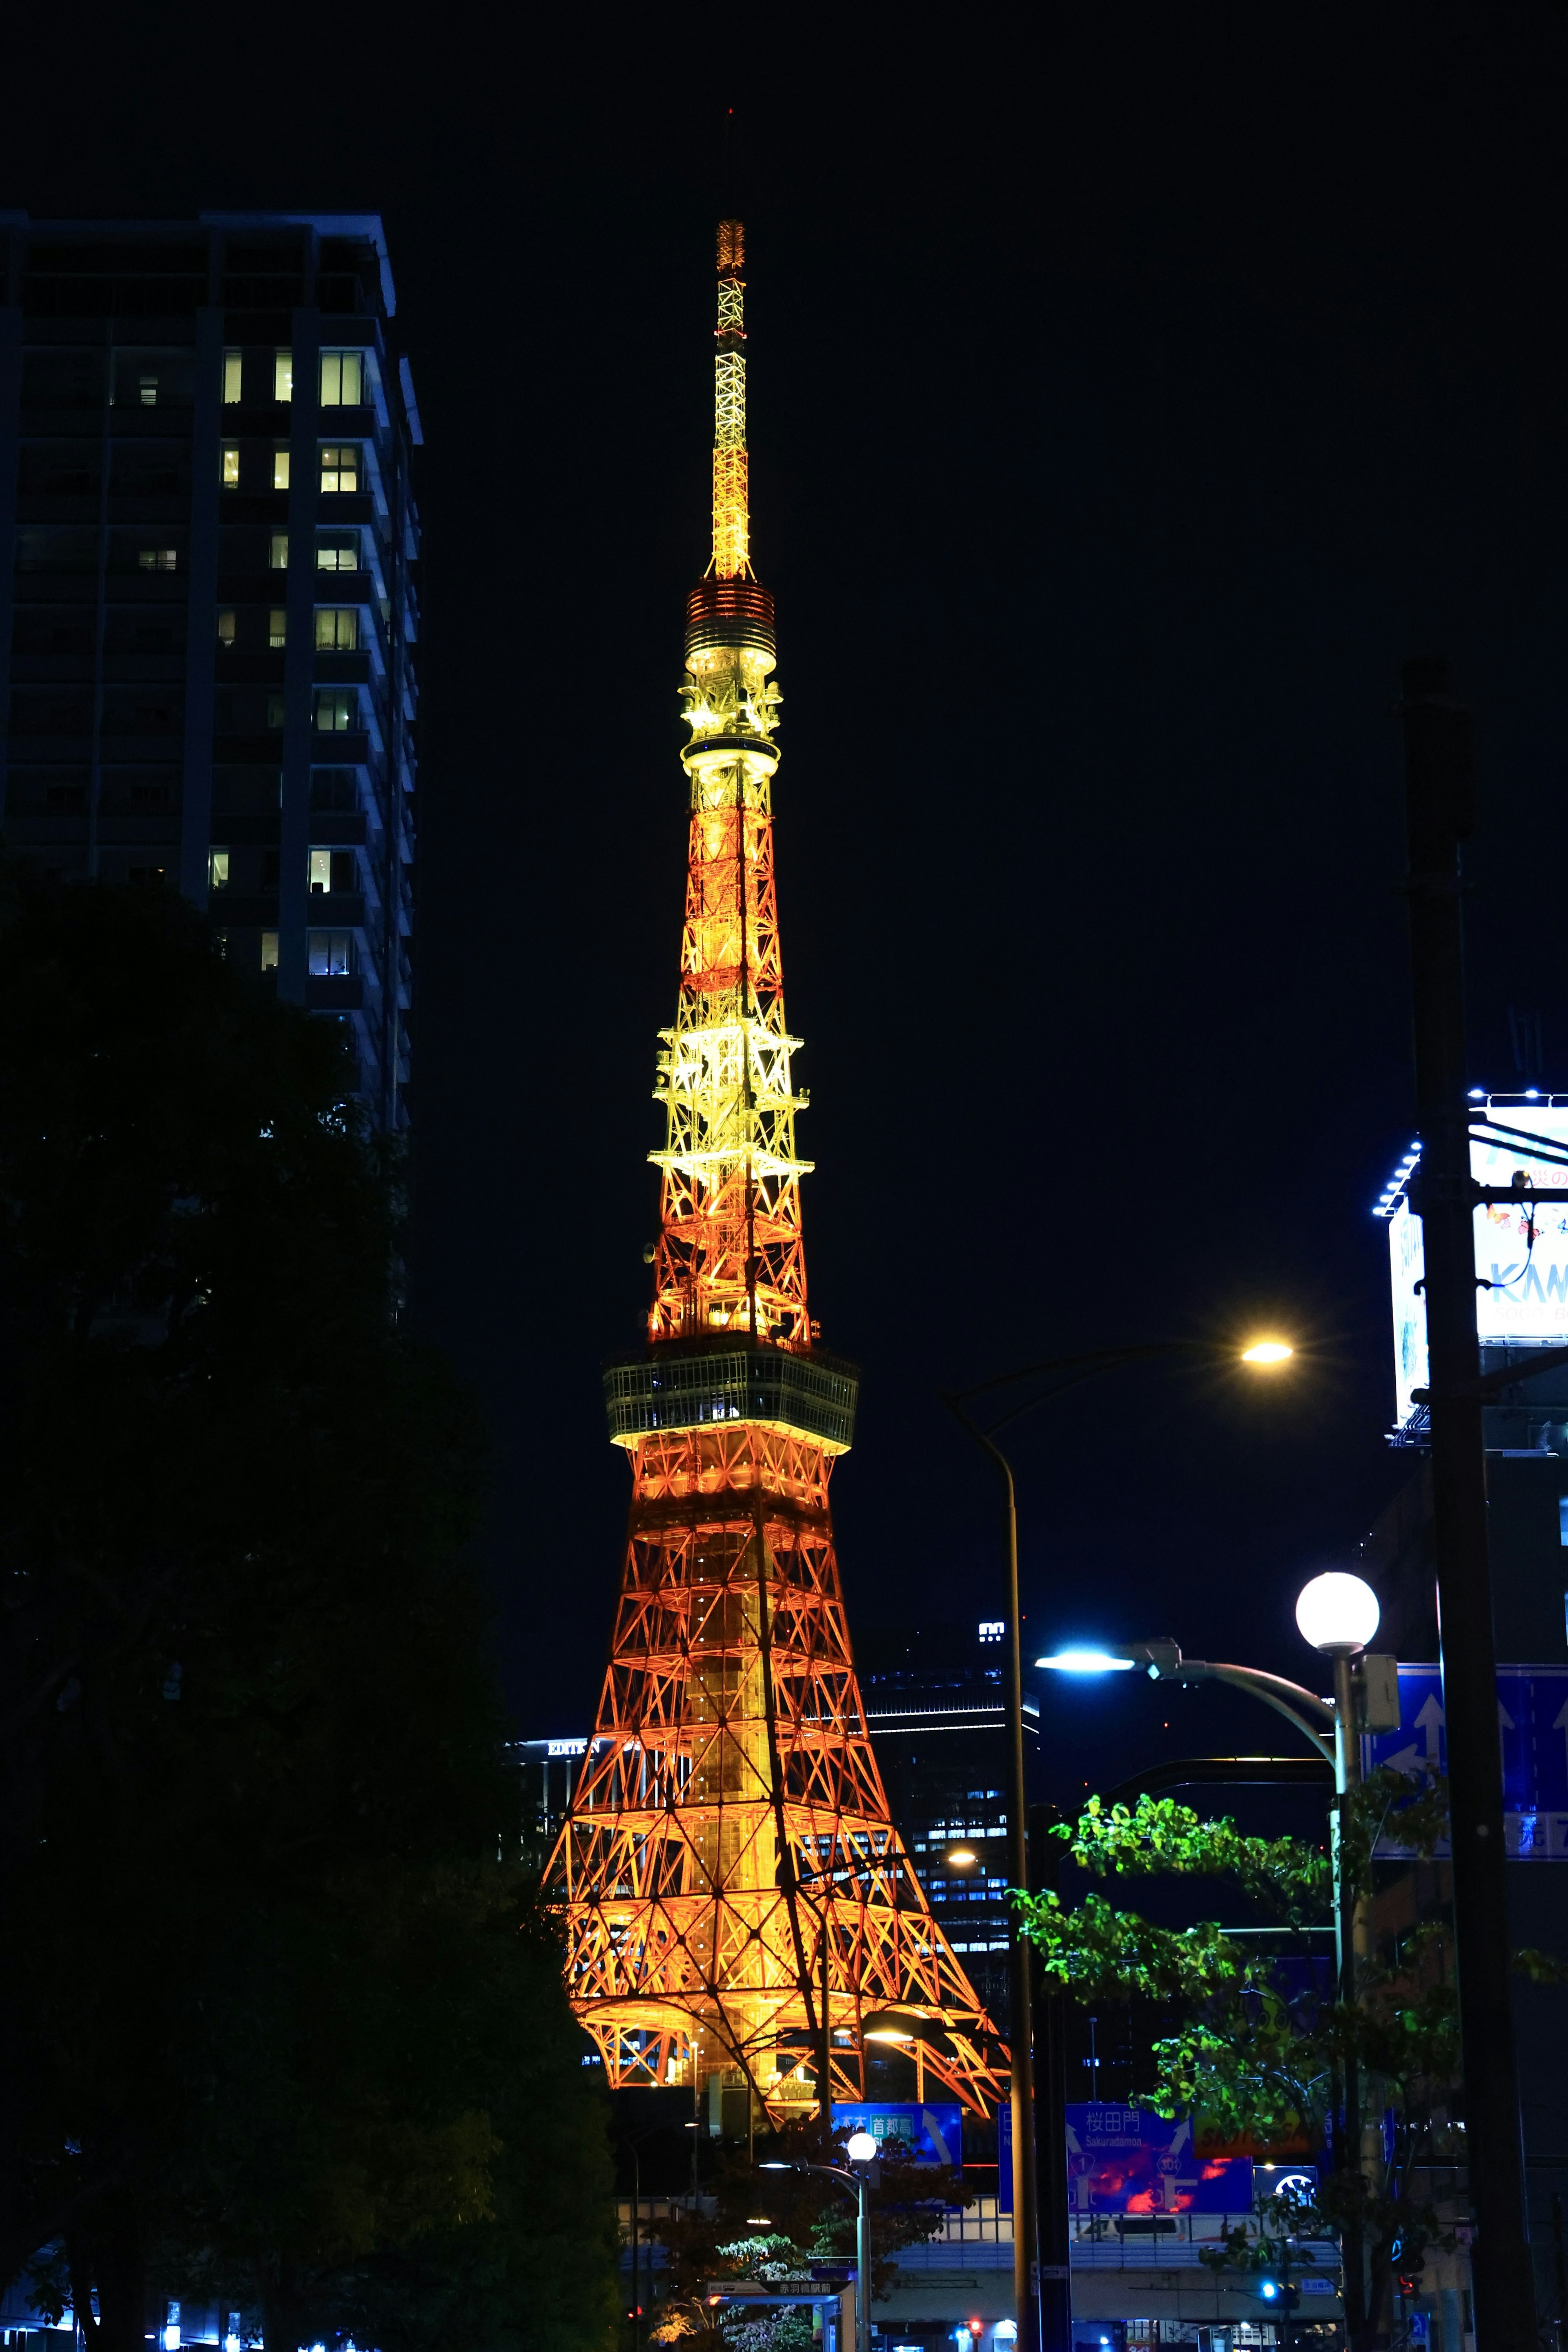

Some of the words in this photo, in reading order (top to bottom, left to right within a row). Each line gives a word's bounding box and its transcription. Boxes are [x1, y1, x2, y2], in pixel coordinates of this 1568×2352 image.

[1555, 1308, 1568, 1320] B
[873, 2118, 911, 2135] 首都高
[1086, 2111, 1139, 2132] 桜田門
[1086, 2135, 1141, 2147] Sakuradamon
[780, 2284, 830, 2293] 赤羽橋駅前
